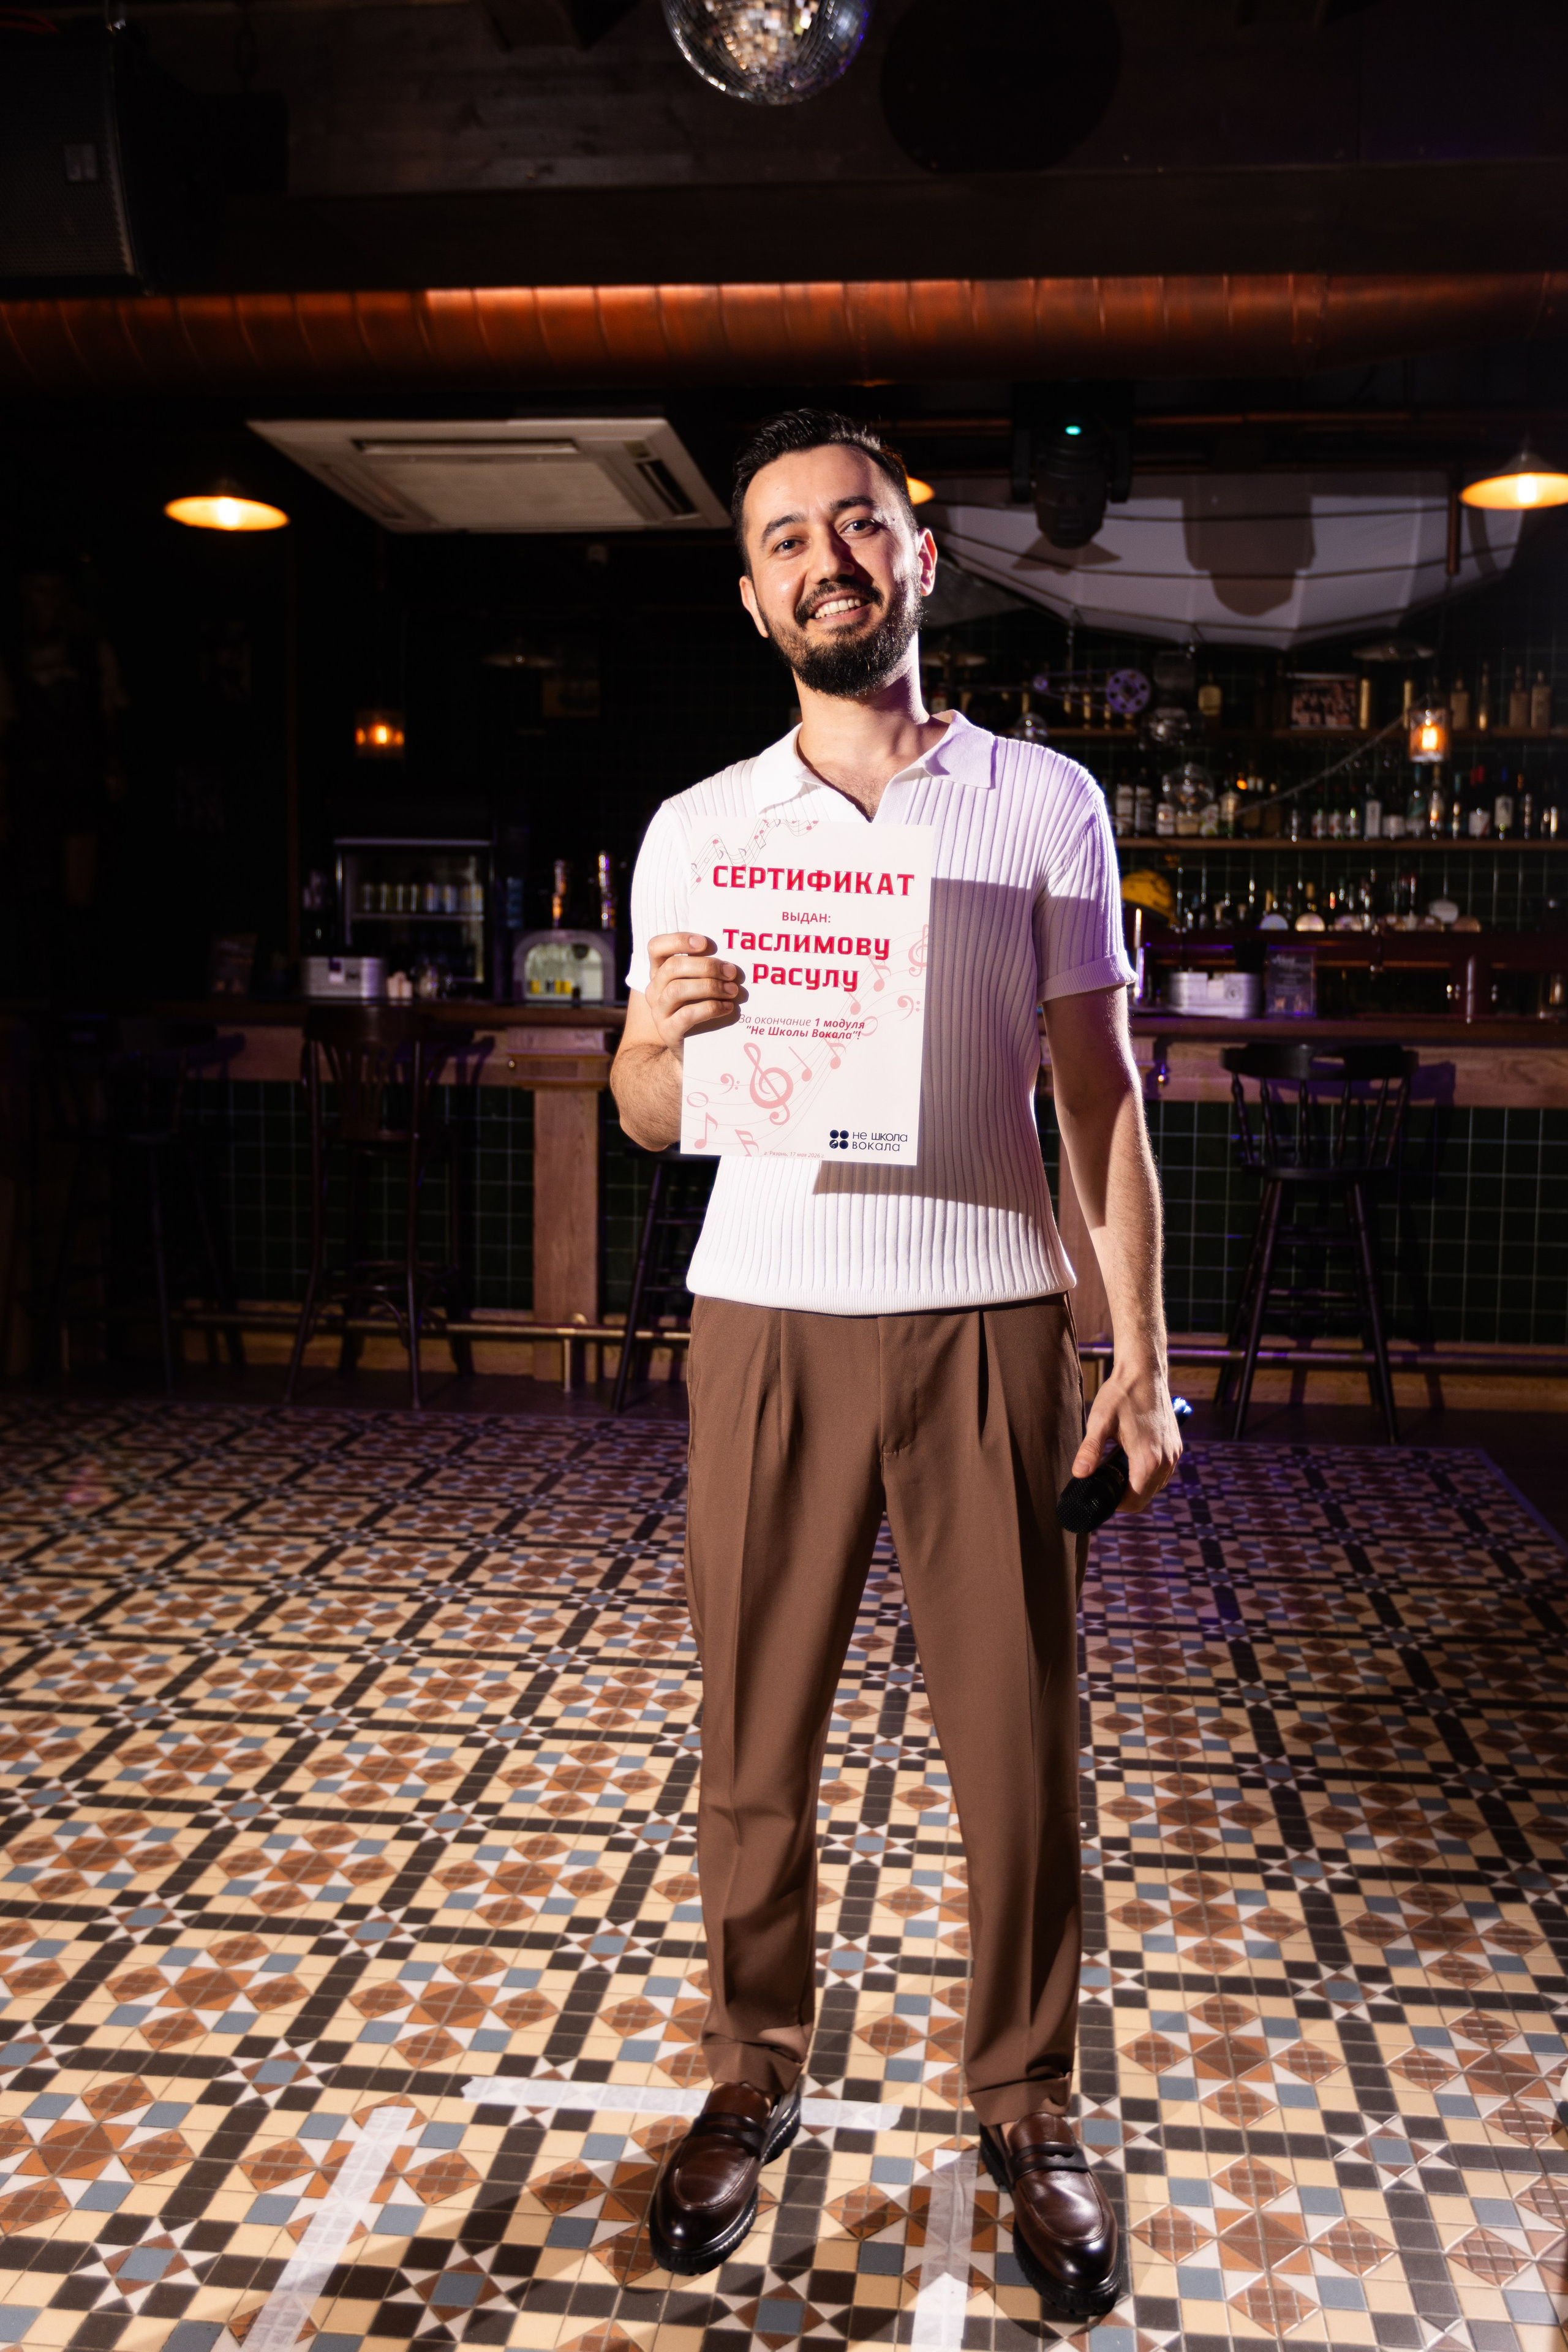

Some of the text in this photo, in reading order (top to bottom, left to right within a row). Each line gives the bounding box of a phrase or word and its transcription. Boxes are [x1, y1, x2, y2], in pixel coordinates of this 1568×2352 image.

[713, 865, 914, 895] СЕРТИФИКАТ
[782, 911, 831, 924] ВЫДАН:
[723, 929, 891, 960] Таслимову
[752, 963, 859, 992] Расулу
[739, 1014, 865, 1031] За окончание 1 модуля
[767, 1027, 809, 1037] Школы
[852, 1131, 908, 1142] не школа
[852, 1141, 900, 1152] вокала
